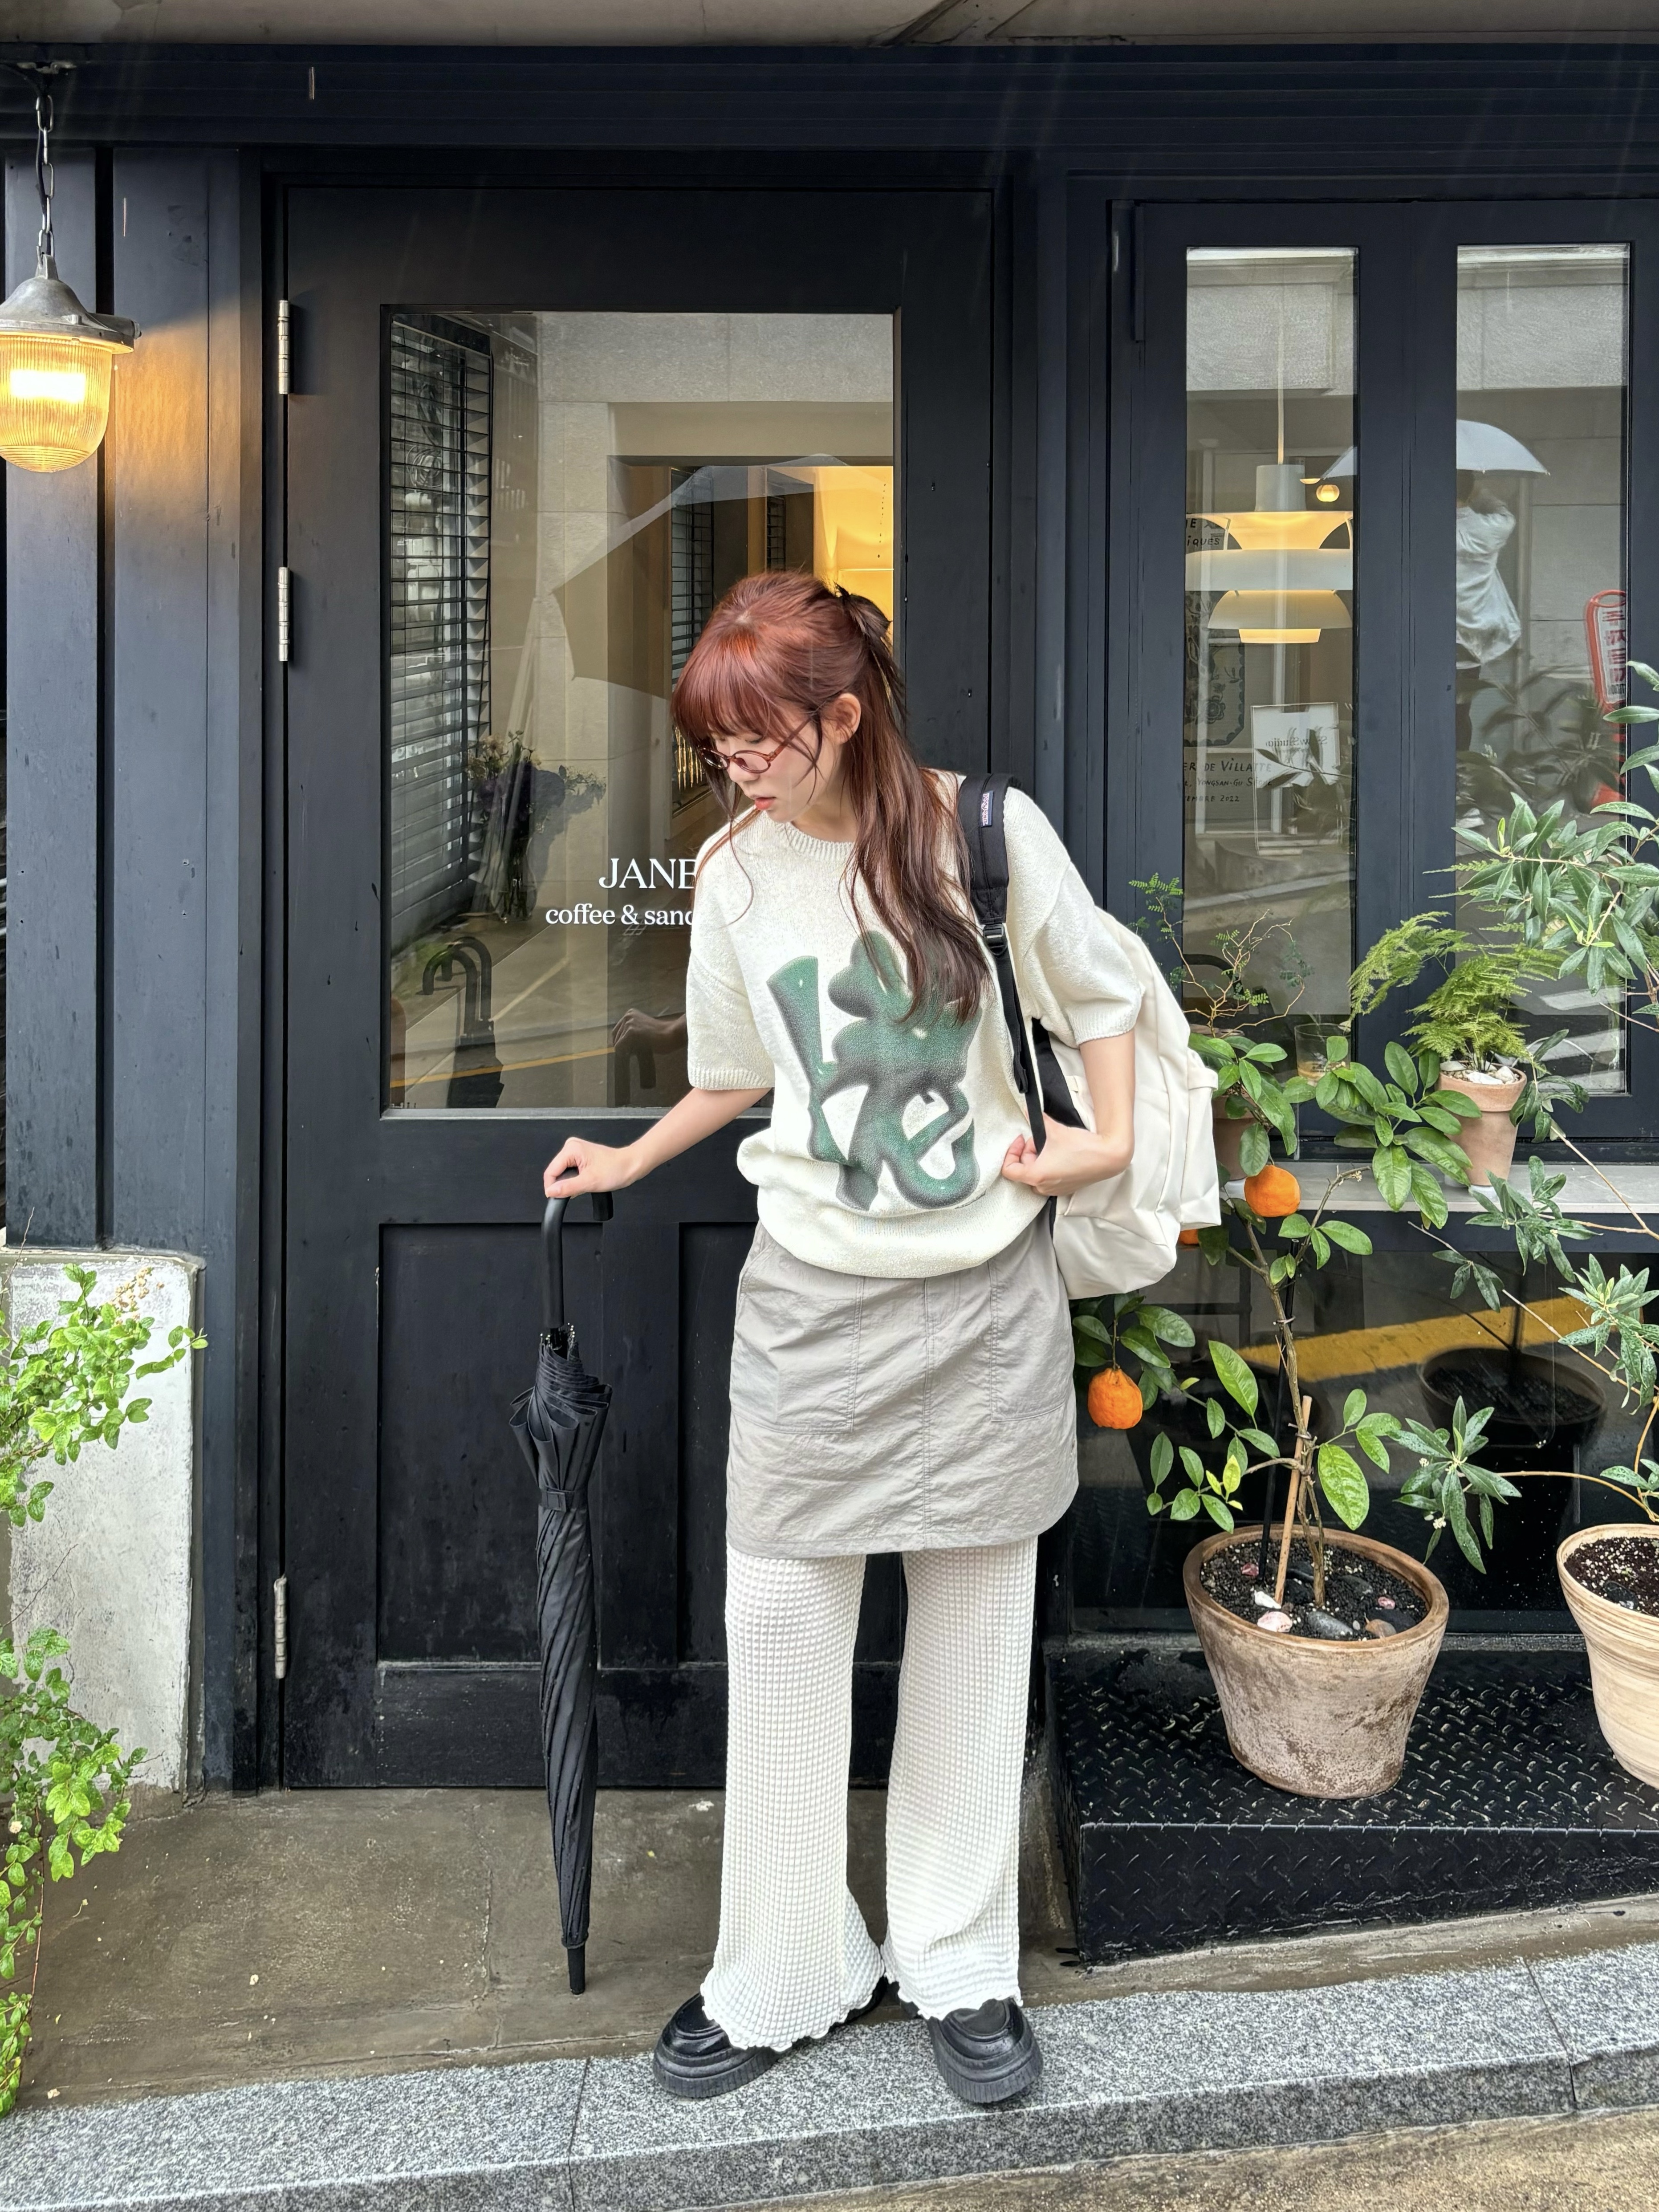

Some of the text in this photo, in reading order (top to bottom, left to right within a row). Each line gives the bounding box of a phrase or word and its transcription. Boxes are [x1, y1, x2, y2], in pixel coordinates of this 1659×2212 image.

[1204, 763, 1216, 771] DE
[545, 903, 615, 925] coffee
[621, 904, 638, 925] &
